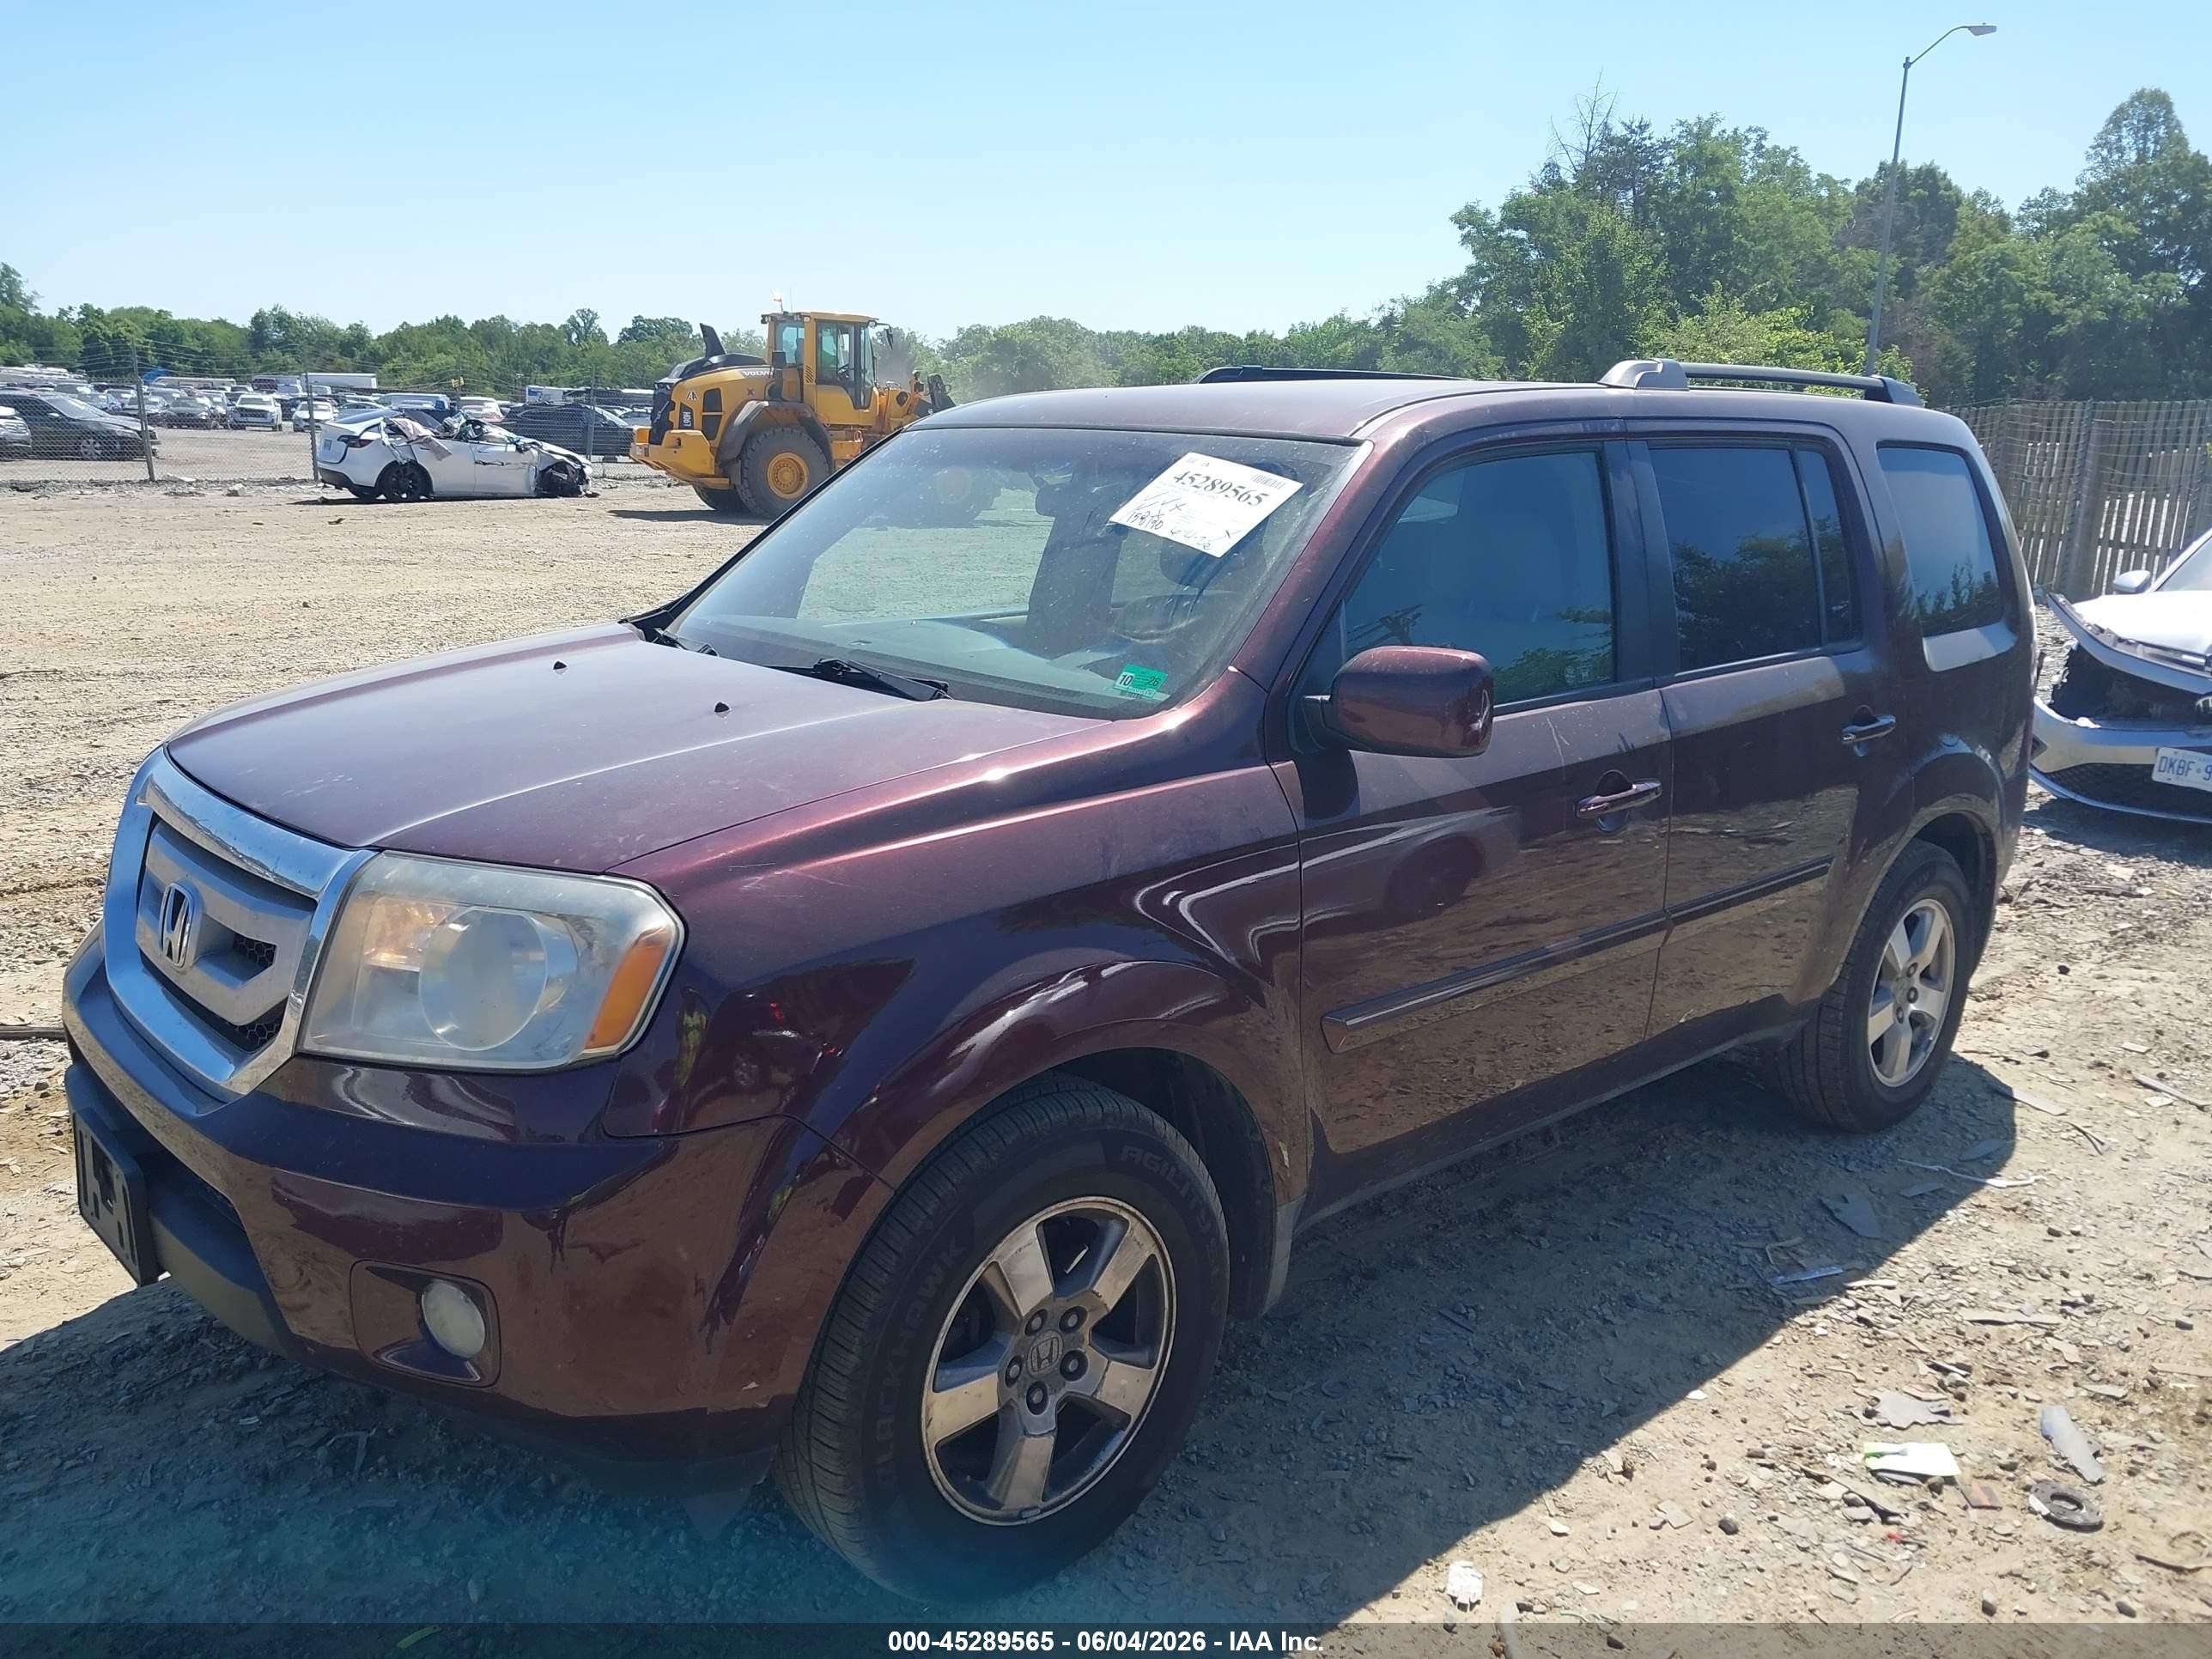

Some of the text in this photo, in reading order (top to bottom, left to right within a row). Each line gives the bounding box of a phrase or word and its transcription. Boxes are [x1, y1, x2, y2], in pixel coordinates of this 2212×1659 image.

[683, 411, 692, 427] L90H
[1174, 471, 1270, 507] 45289565
[1119, 674, 1161, 687] 10 26
